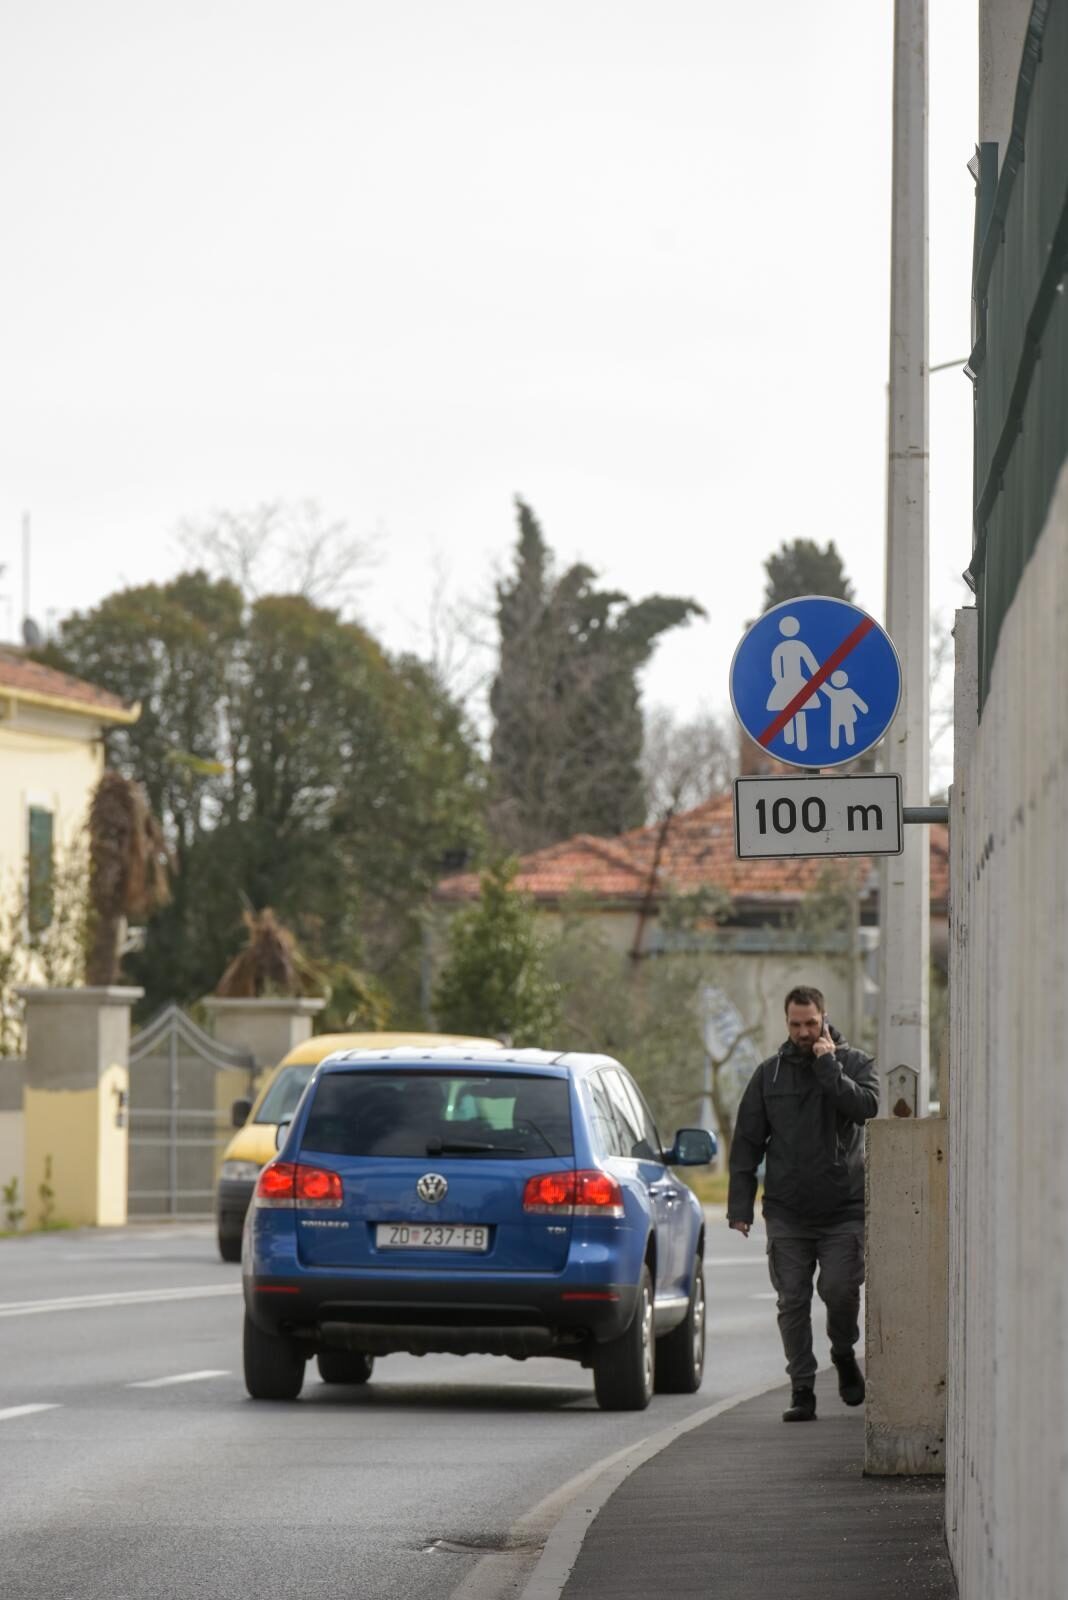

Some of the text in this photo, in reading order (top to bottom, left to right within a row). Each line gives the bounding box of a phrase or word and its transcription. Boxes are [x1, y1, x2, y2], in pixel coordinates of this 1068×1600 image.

[755, 796, 883, 834] 100 m
[389, 1226, 485, 1246] ZD 237-FB
